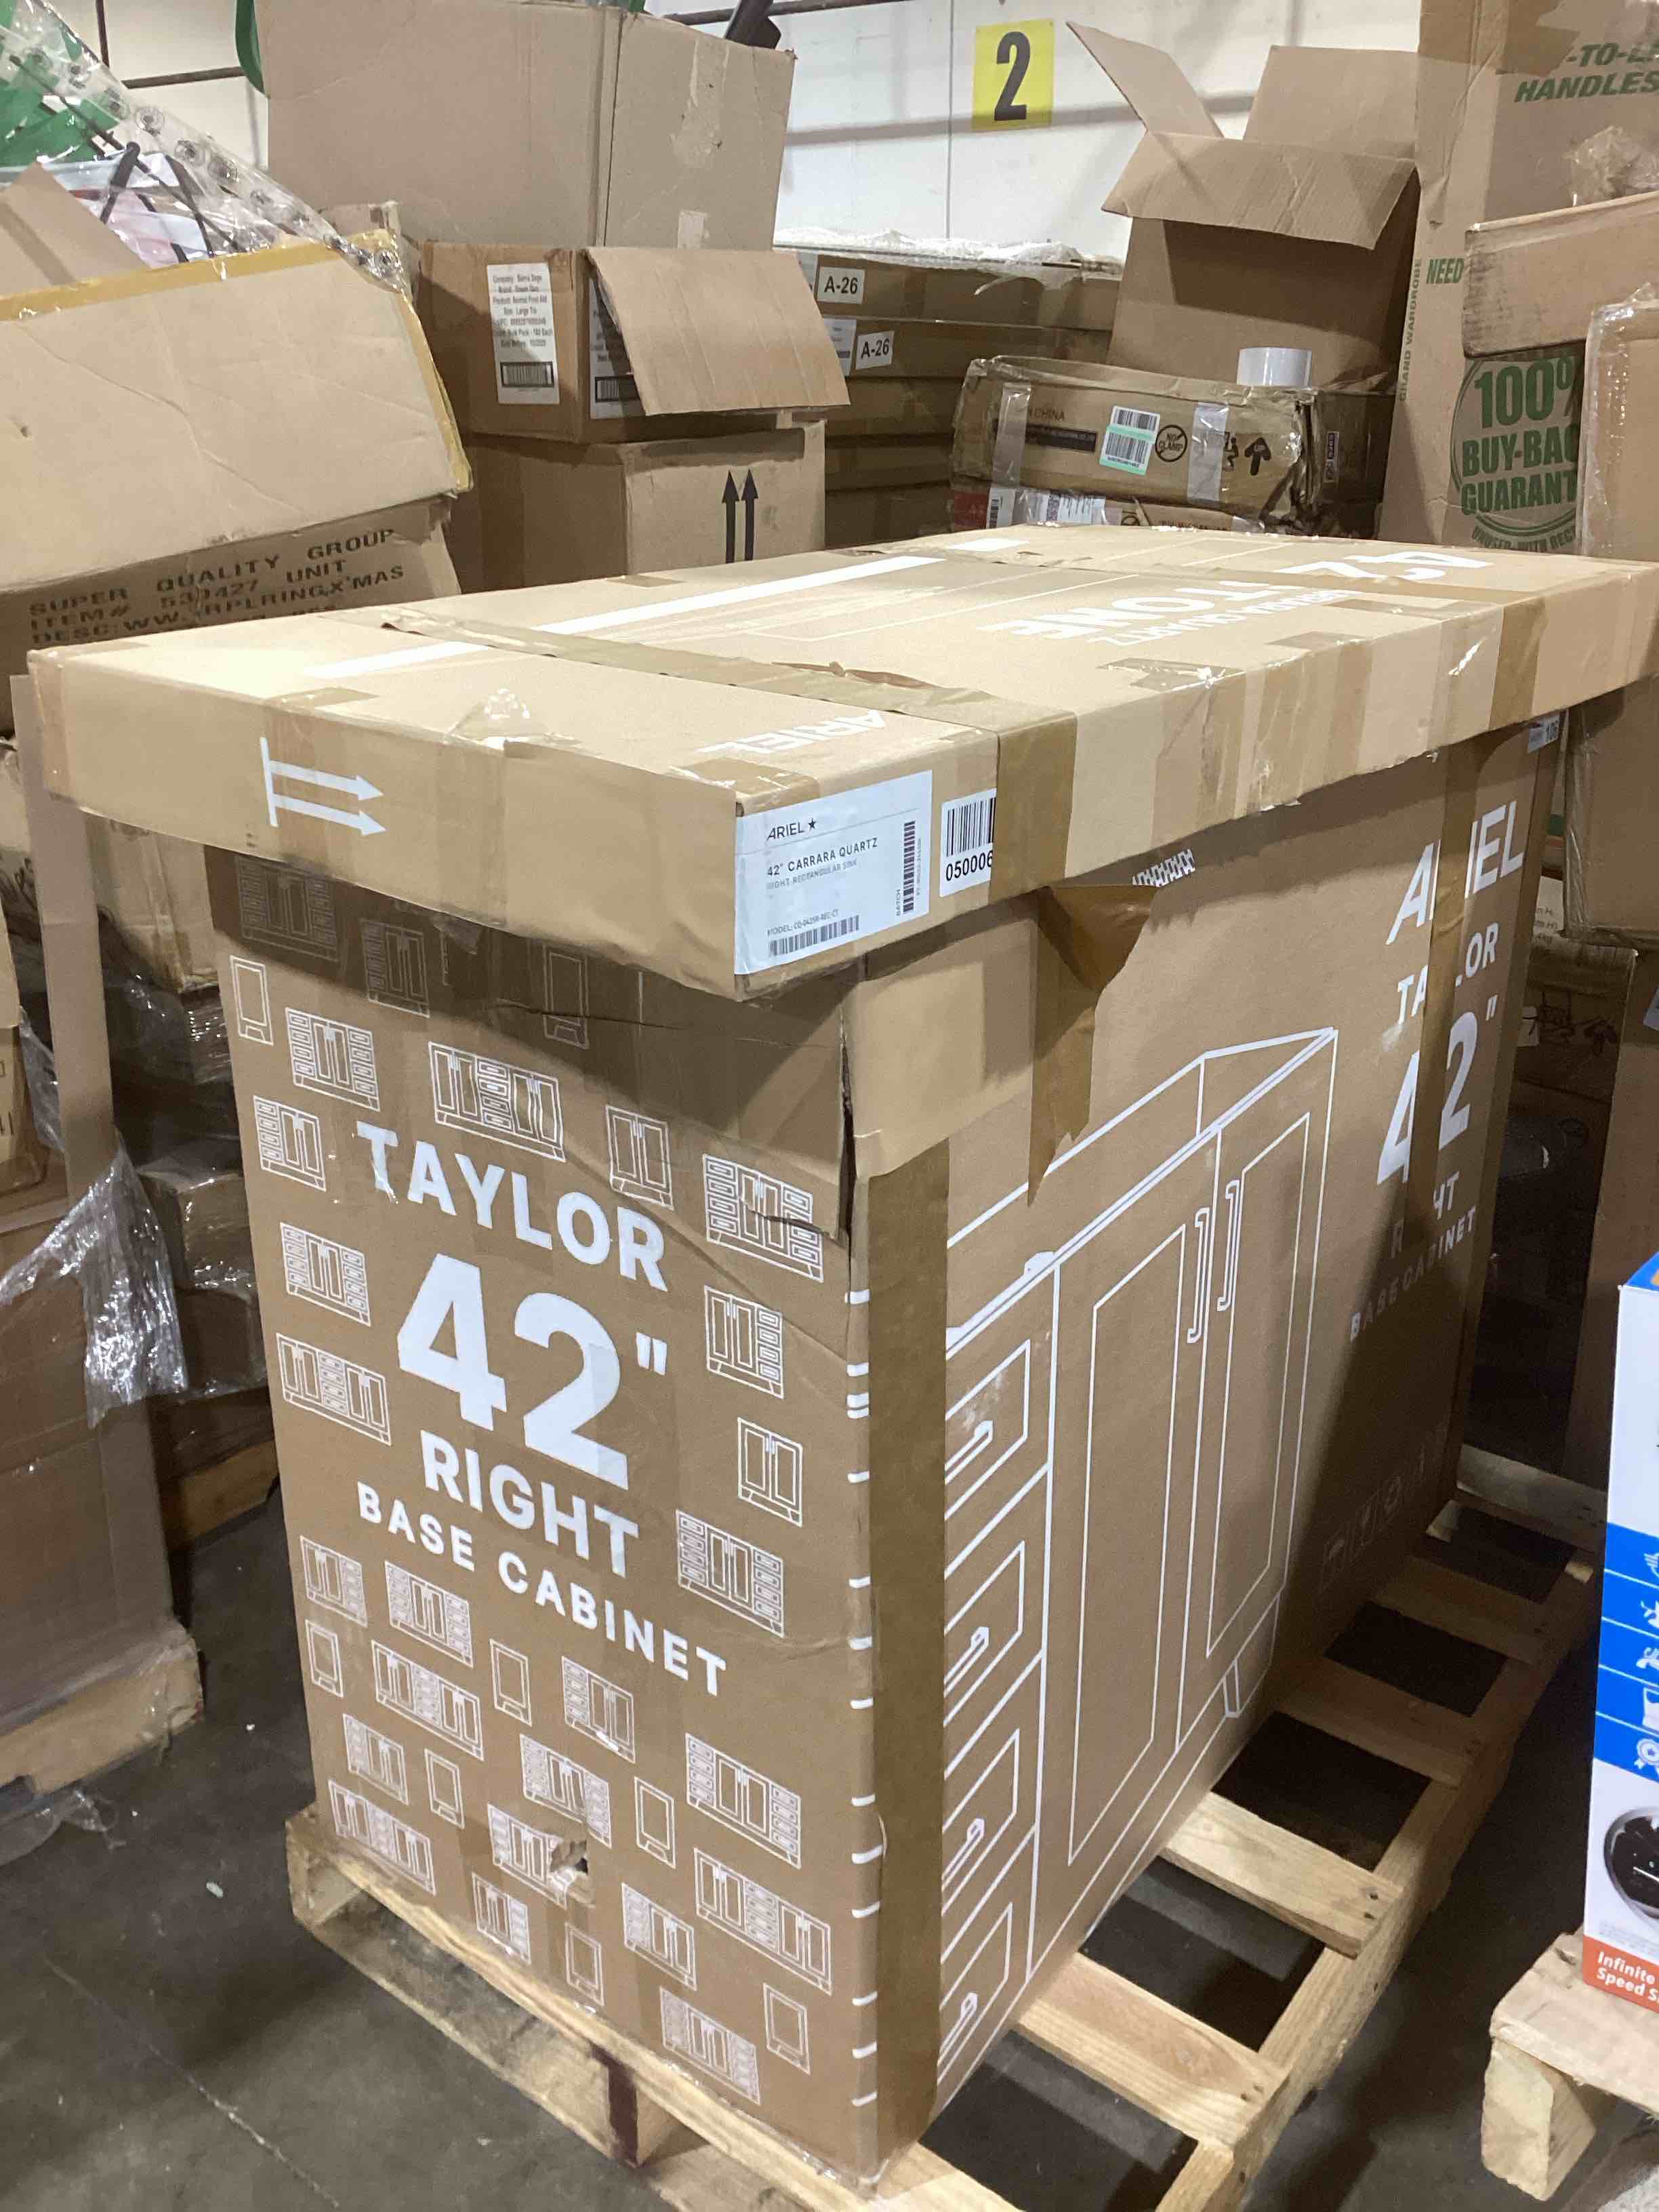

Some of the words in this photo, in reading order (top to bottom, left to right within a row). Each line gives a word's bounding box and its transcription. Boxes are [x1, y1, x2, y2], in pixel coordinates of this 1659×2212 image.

[994, 30, 1031, 122] 2
[824, 276, 859, 294] A-26
[861, 338, 890, 359] A-26
[29, 587, 129, 616] SUPER
[157, 554, 281, 592] QUALITY
[307, 529, 394, 560] GROUP
[286, 558, 346, 583] UNIT
[693, 710, 886, 753] ARIEL
[766, 821, 805, 841] ARIEL
[767, 863, 783, 876] 42"
[787, 849, 836, 872] CARRARA
[839, 837, 878, 857] QUARTZ
[766, 925, 794, 937] MODEL:
[355, 1120, 668, 1292] TAYLOR
[397, 1252, 668, 1490] 42"
[420, 1430, 639, 1578] RIGHT
[356, 1481, 476, 1572] BASE
[498, 1552, 727, 1697] CABINET
[1596, 1967, 1646, 1996] Speed
[1597, 1950, 1656, 1985] Infinite
